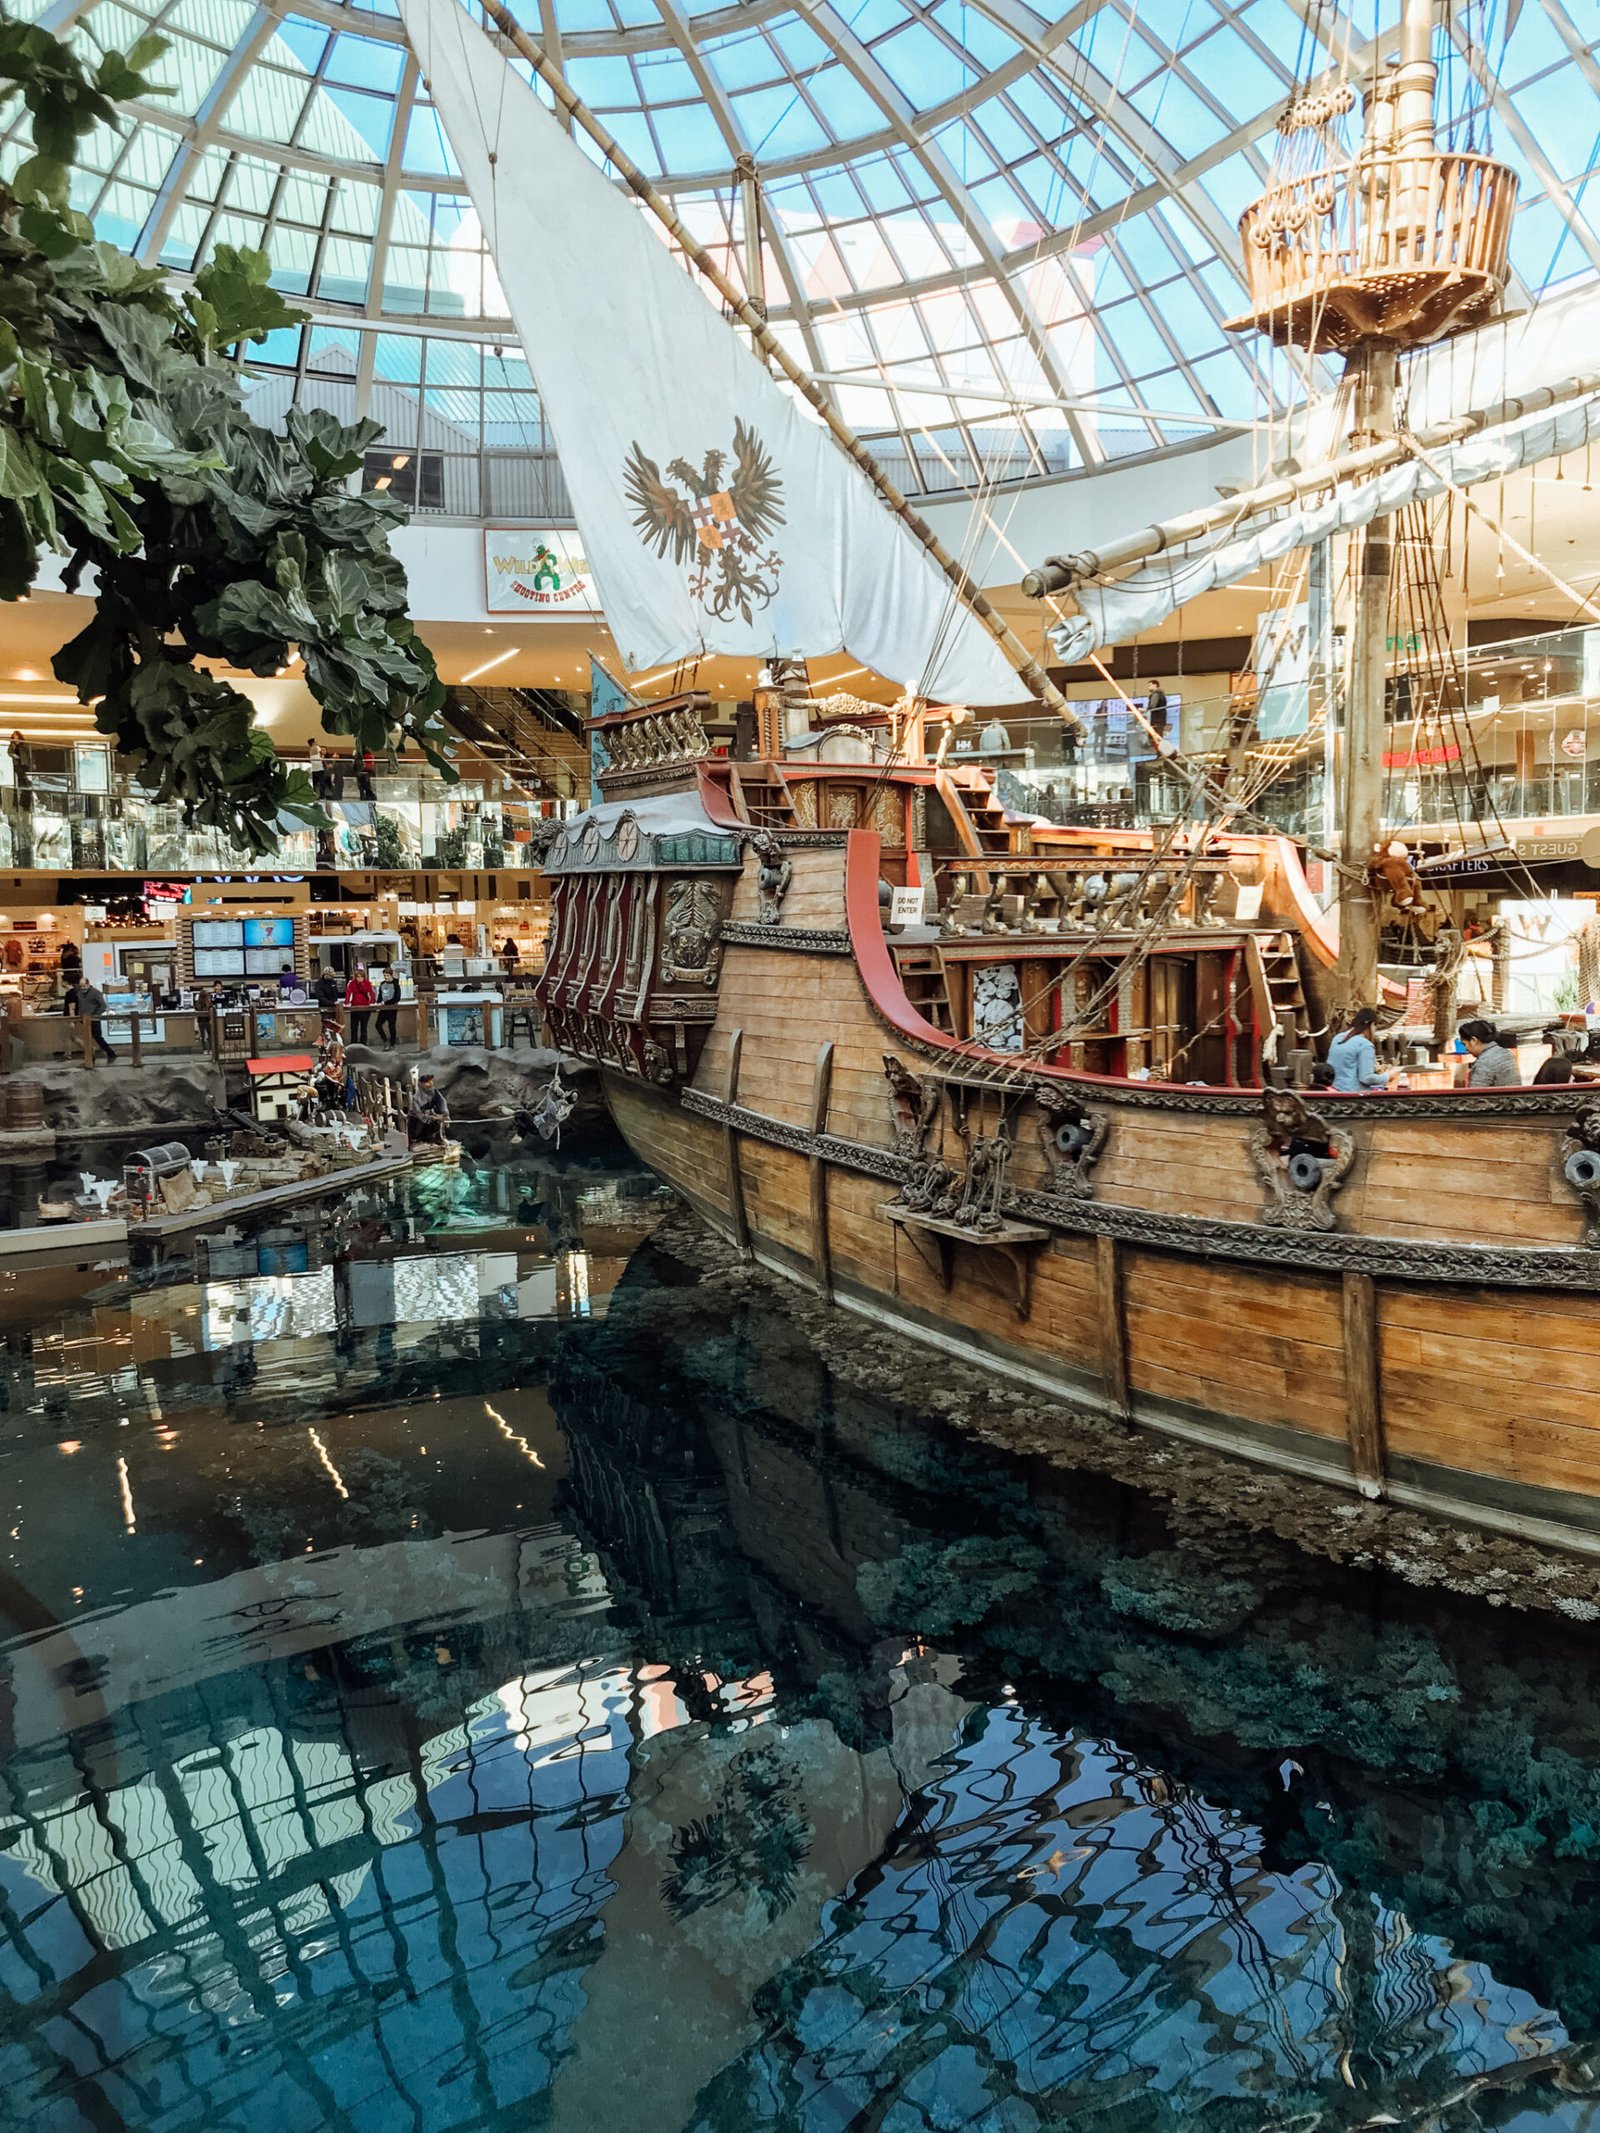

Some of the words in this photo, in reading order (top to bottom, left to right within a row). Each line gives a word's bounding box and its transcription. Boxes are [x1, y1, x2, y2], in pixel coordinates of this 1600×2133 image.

[558, 555, 591, 575] WES
[510, 580, 551, 604] SHOOTING
[553, 579, 587, 603] CENTRE
